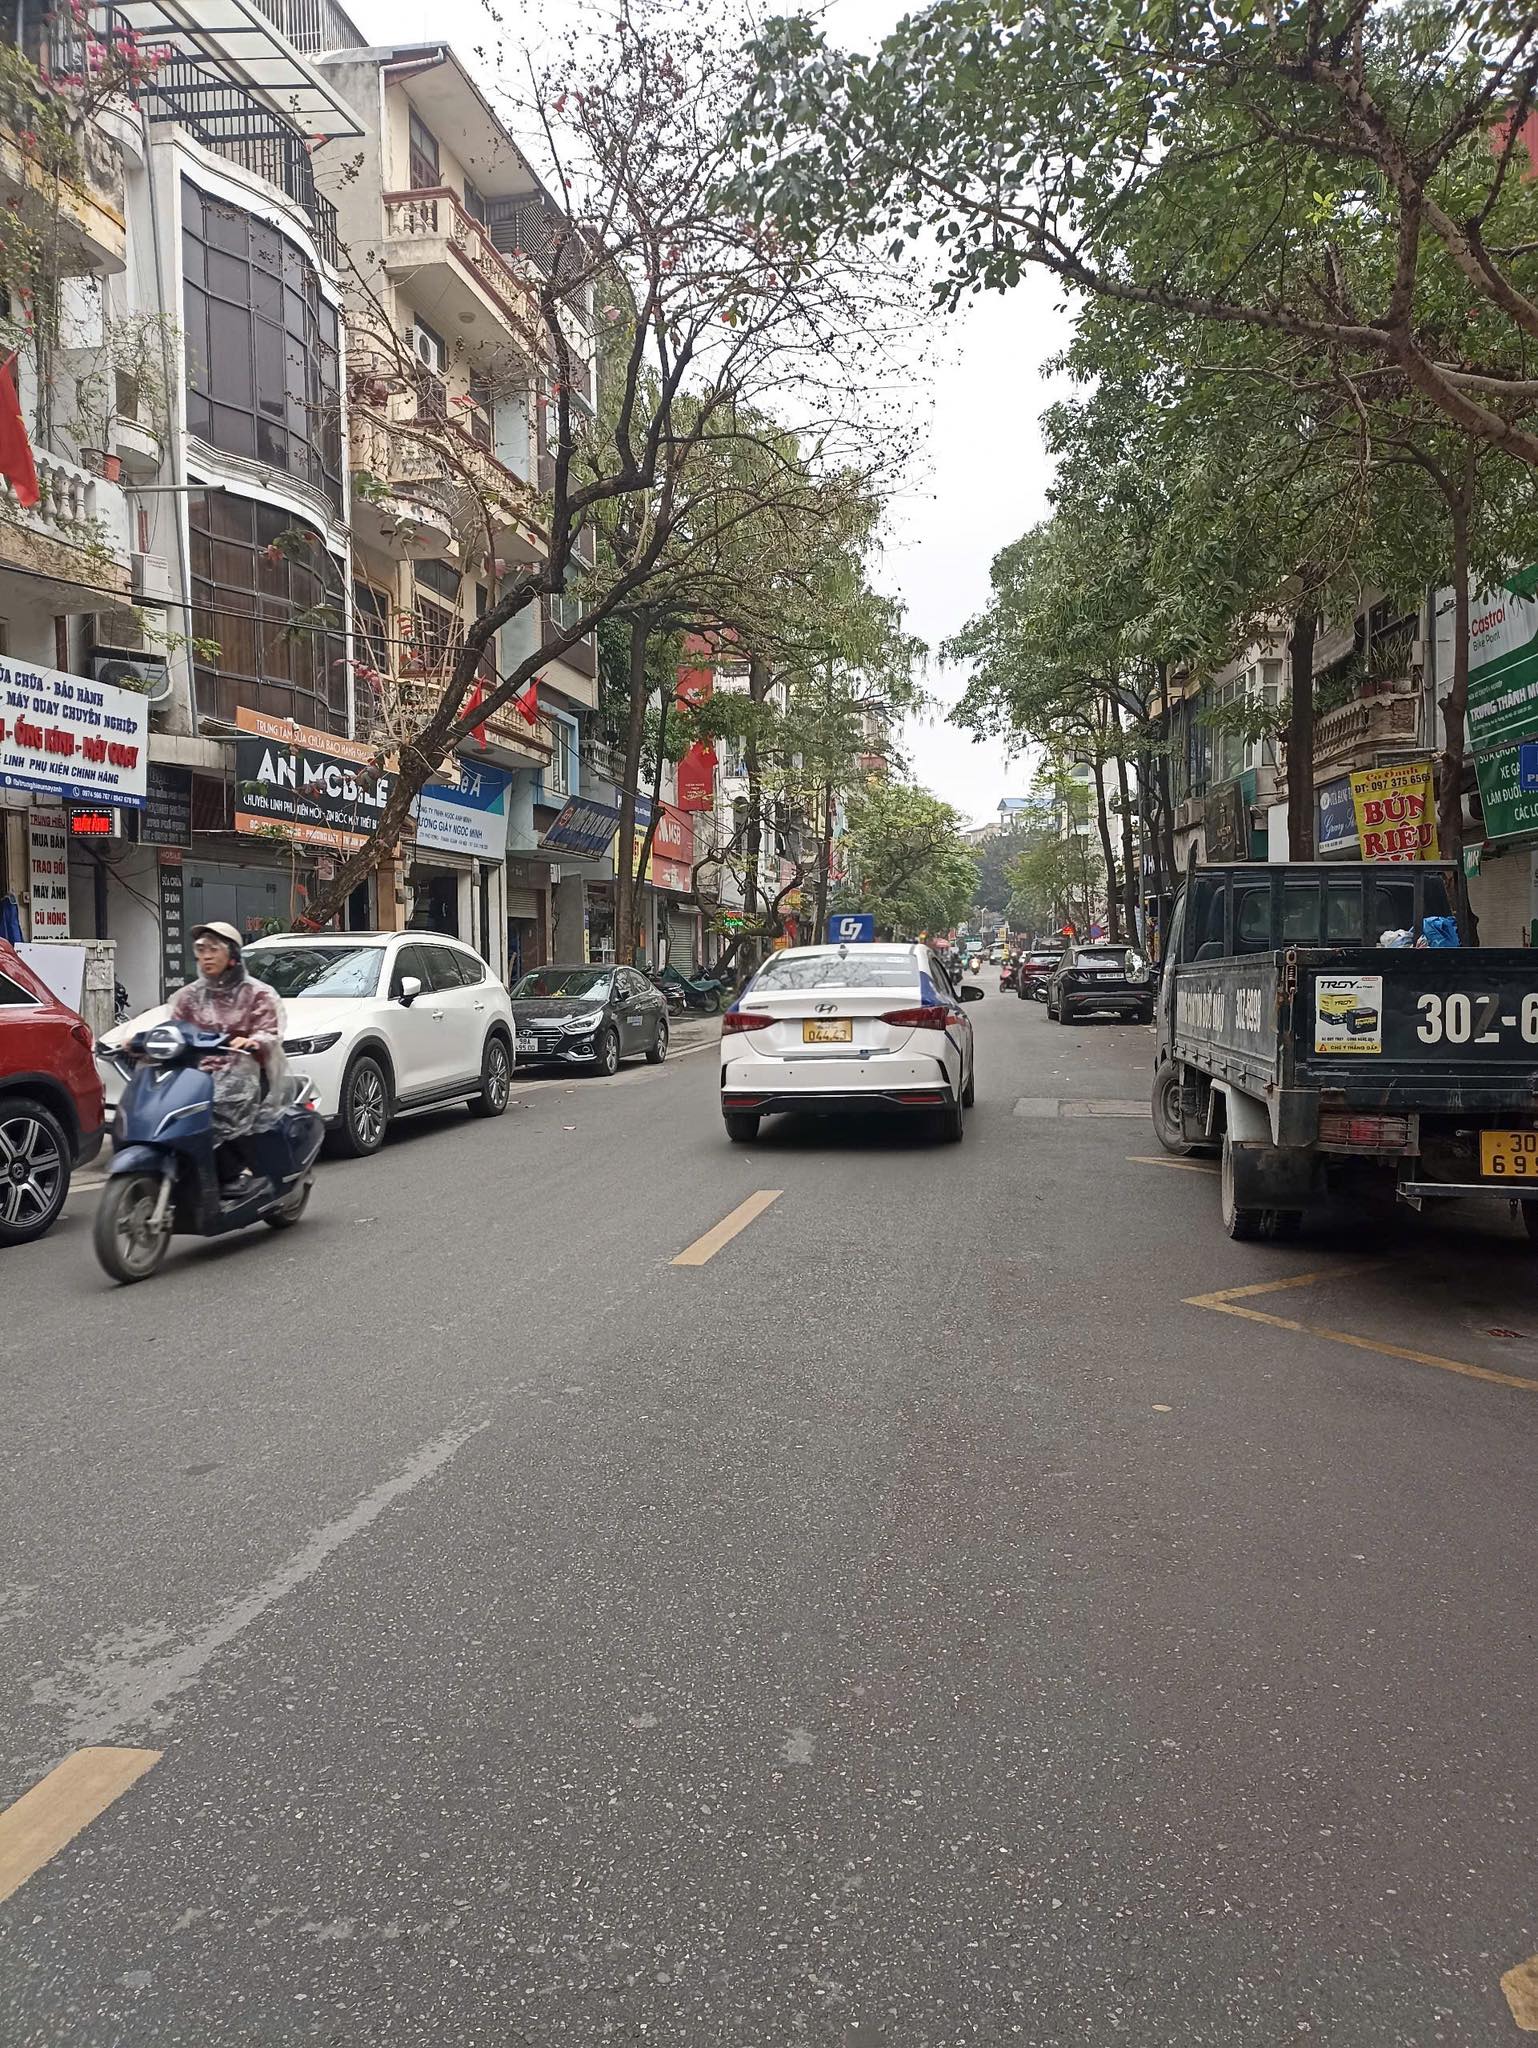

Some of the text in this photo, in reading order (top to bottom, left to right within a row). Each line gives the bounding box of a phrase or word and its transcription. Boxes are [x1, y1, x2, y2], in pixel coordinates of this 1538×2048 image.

[1471, 603, 1506, 637] Castrol
[15, 672, 43, 691] CHỮA
[54, 680, 74, 699] BẢO
[77, 687, 104, 707] HÀNH
[6, 690, 138, 735] MÁY QUAY CHUYÊN NGHIỆP
[1470, 700, 1498, 722] TRUNG
[1497, 689, 1527, 711] THÀNH
[256, 719, 278, 737] TRUNG
[3, 754, 25, 768] LINH
[29, 758, 47, 774] PHỤ
[1500, 766, 1510, 780] XE
[1371, 780, 1388, 791] 097
[1391, 776, 1408, 788] 375
[1486, 789, 1502, 806] LÀM
[1362, 791, 1425, 826] BÚN
[1514, 803, 1530, 821] CÁC
[32, 832, 65, 849] MUA BÁN
[1363, 821, 1434, 858] RIÊU
[32, 860, 51, 873] TRAO
[33, 882, 66, 899] MÁY ẢNH
[34, 907, 66, 926] CŨ HỎNG
[840, 918, 862, 940] G7
[1320, 980, 1358, 989] TROY
